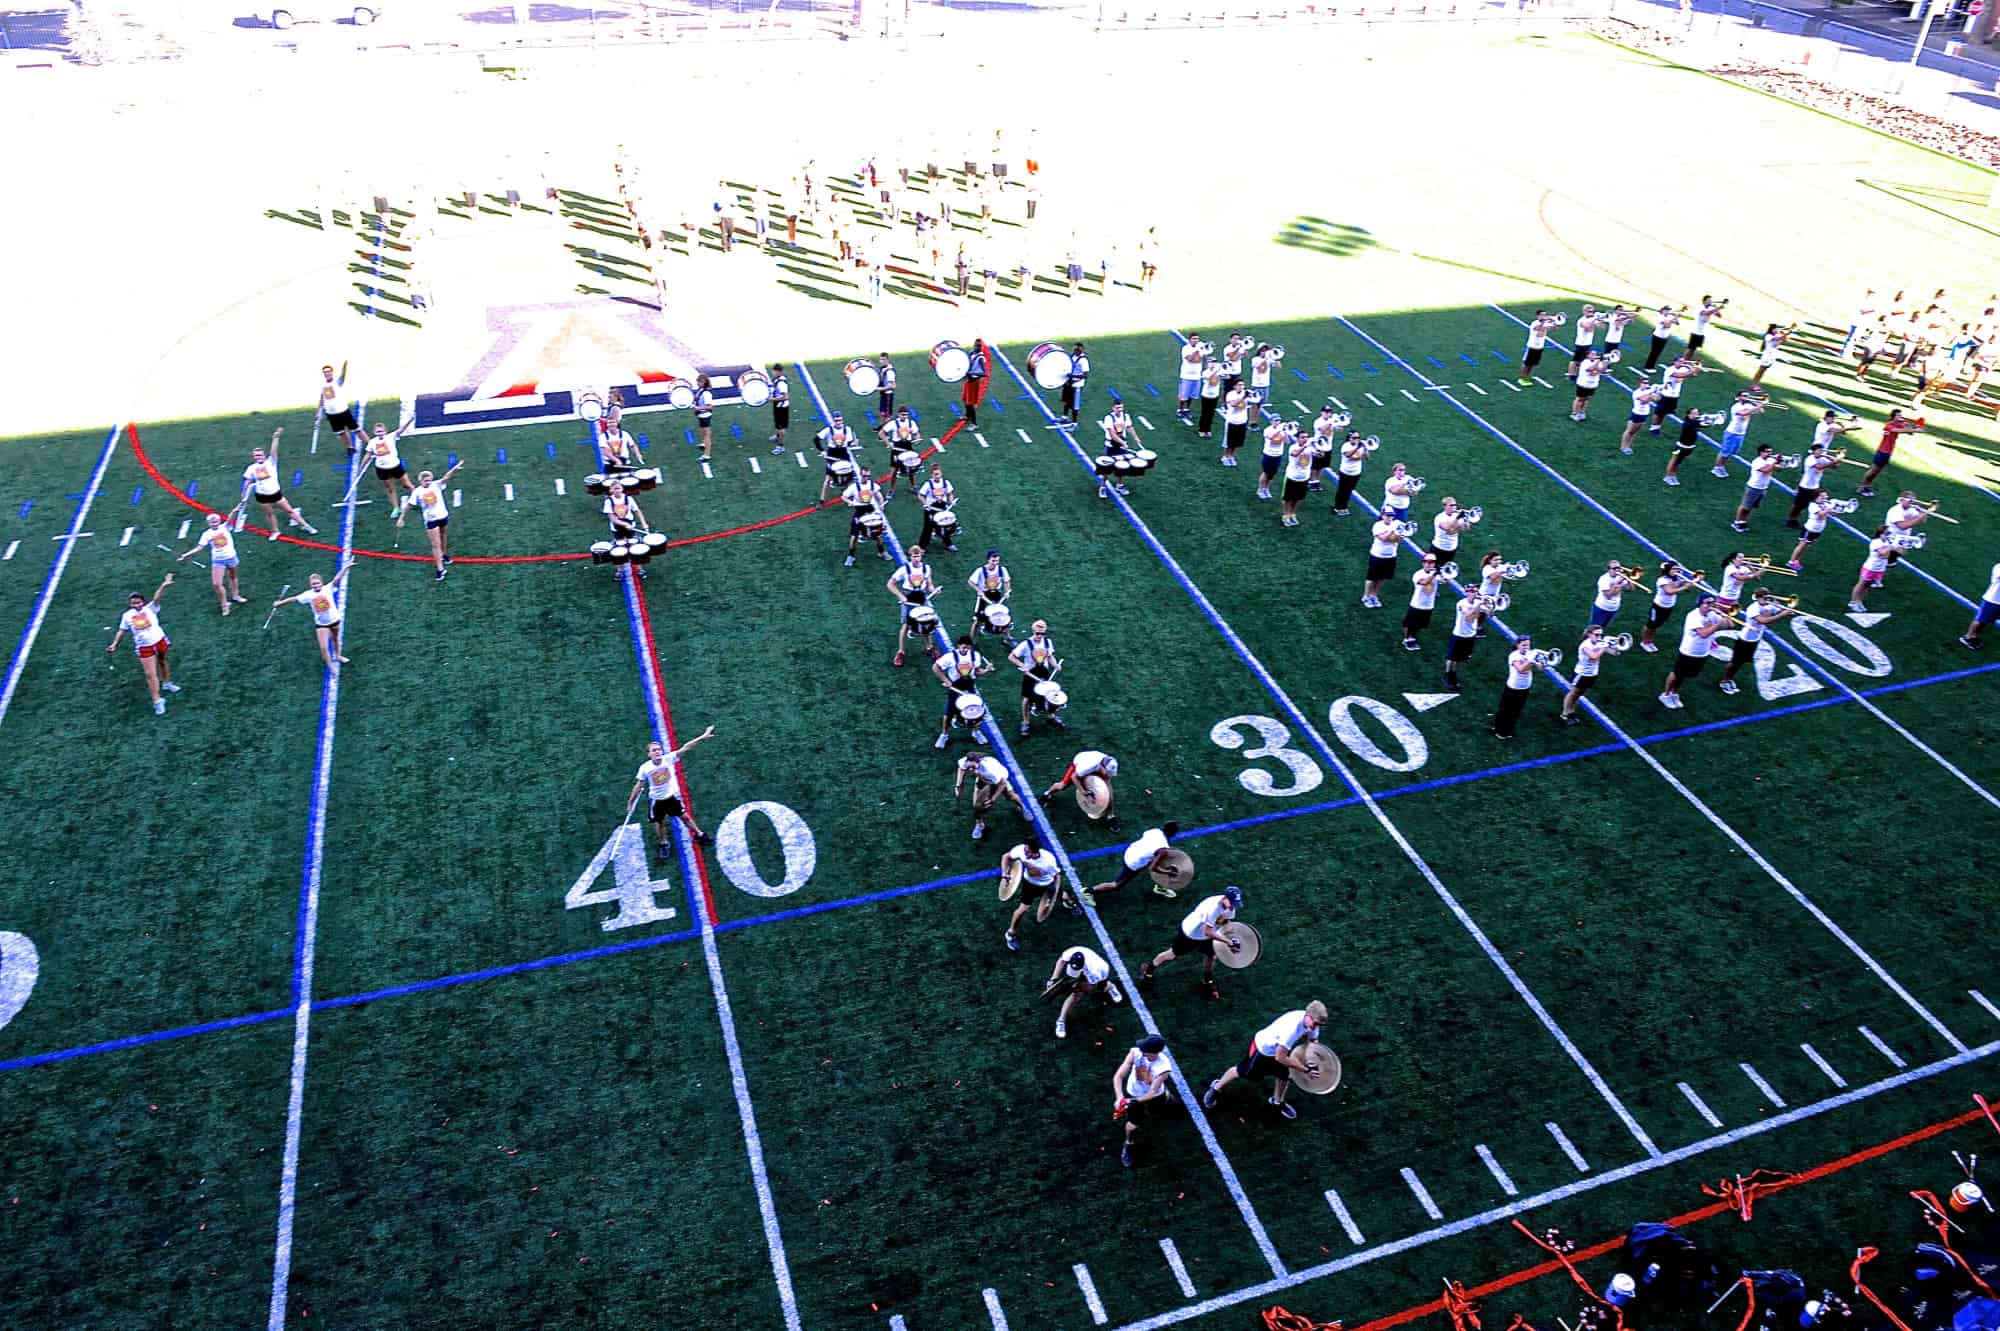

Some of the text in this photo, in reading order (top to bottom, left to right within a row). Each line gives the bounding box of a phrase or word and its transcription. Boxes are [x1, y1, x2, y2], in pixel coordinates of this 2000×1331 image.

[1708, 615, 1893, 701] 20
[1209, 695, 1429, 797] 30
[564, 800, 817, 932] 40
